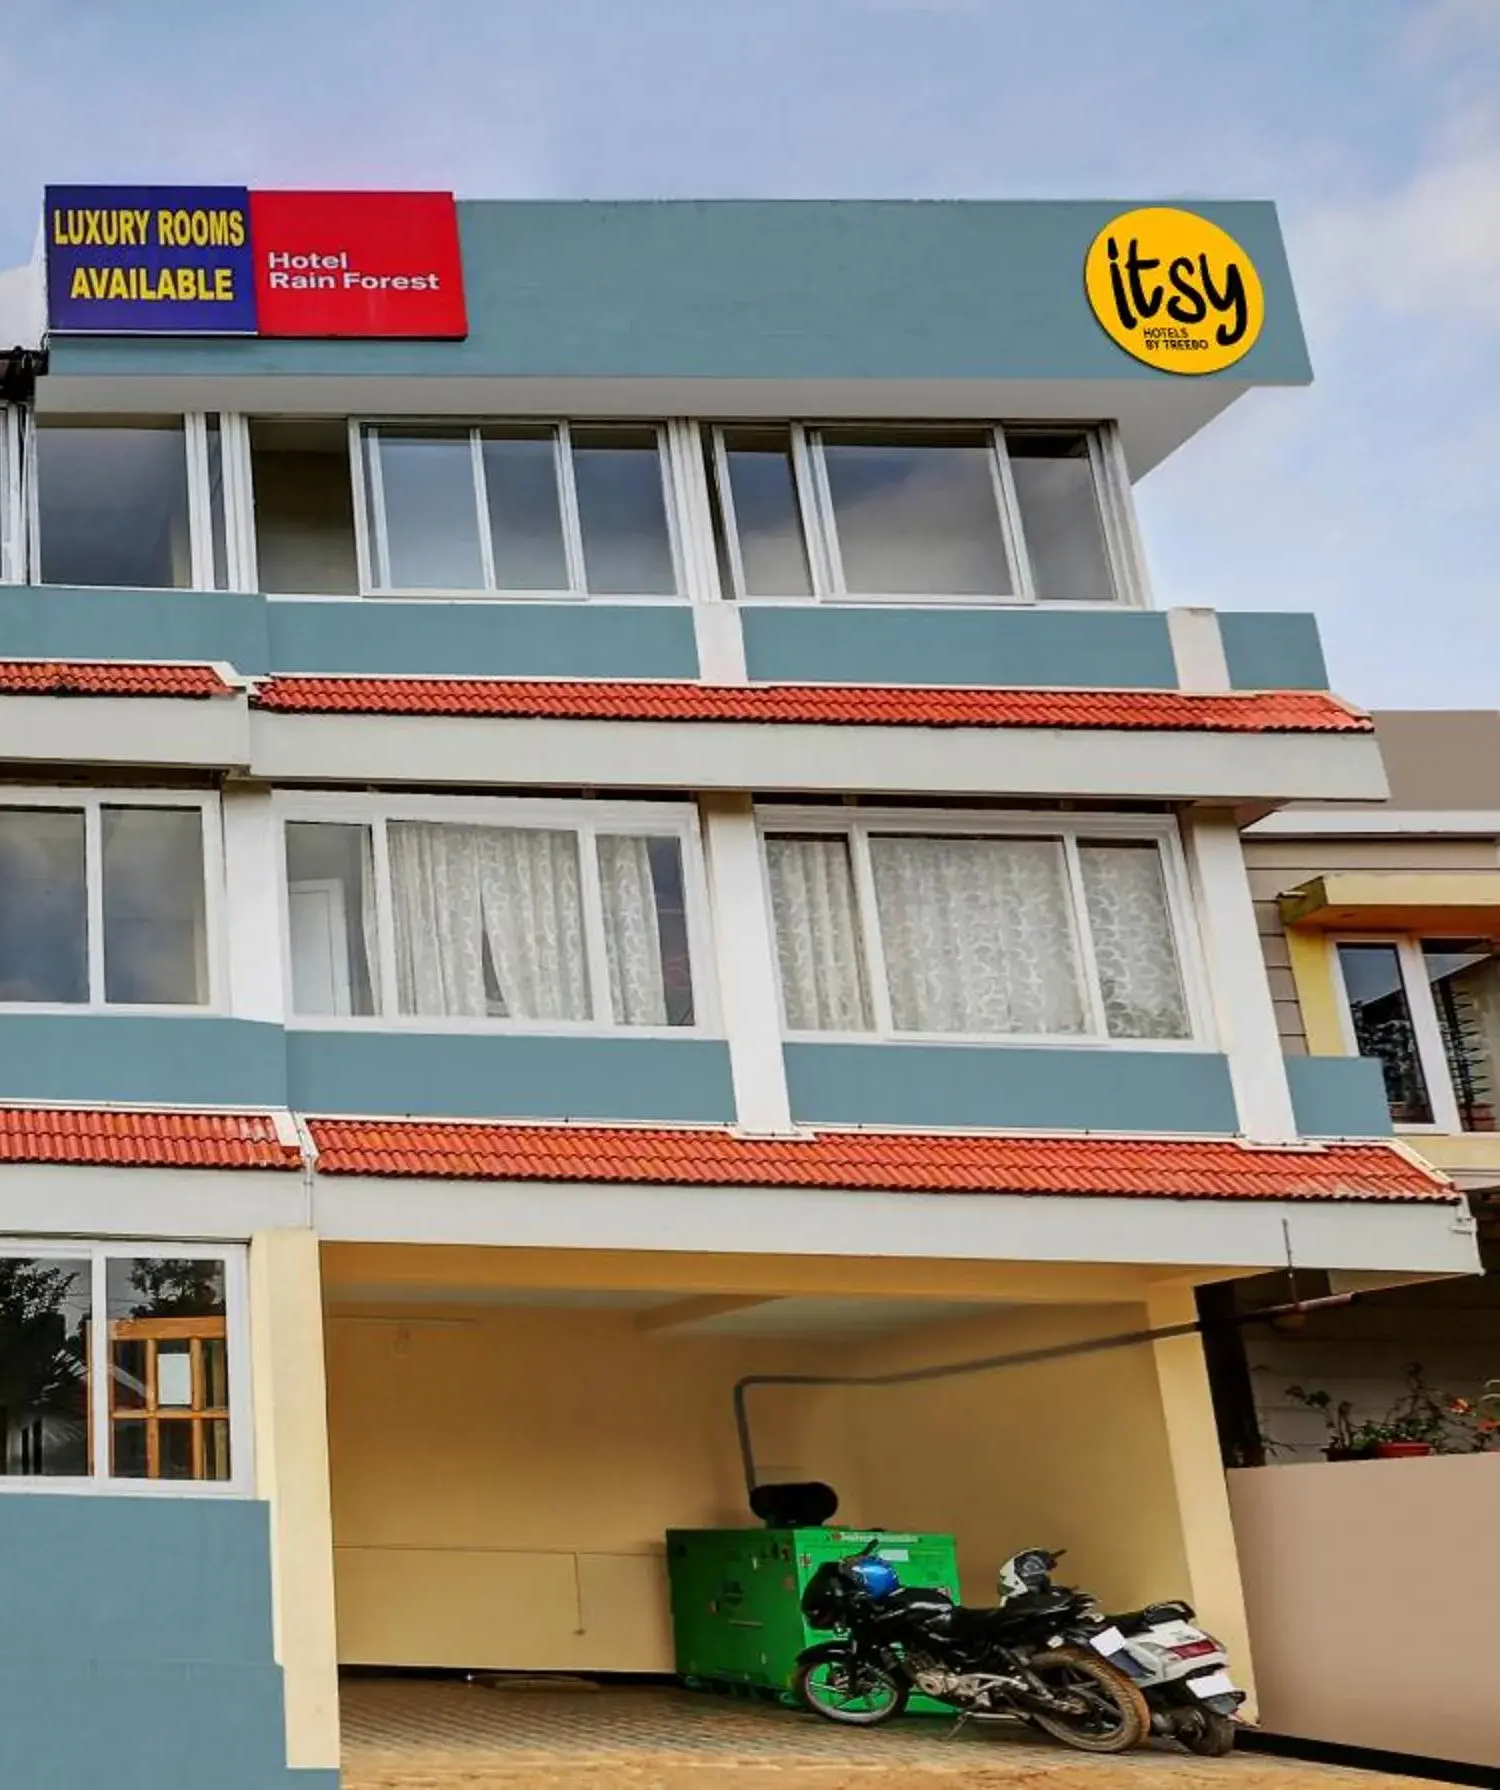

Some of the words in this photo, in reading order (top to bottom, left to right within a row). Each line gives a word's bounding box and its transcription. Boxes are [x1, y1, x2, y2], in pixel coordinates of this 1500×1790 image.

[54, 209, 150, 246] LUXURY
[157, 209, 245, 247] ROOMS
[268, 252, 348, 270] Hotel
[70, 267, 234, 301] AVAILABLE
[269, 271, 336, 290] Rain
[344, 272, 441, 291] Forest
[1107, 236, 1248, 346] itsy
[1143, 327, 1189, 339] HOTELS
[1145, 339, 1160, 350] BY
[1163, 339, 1209, 351] TREEBO
